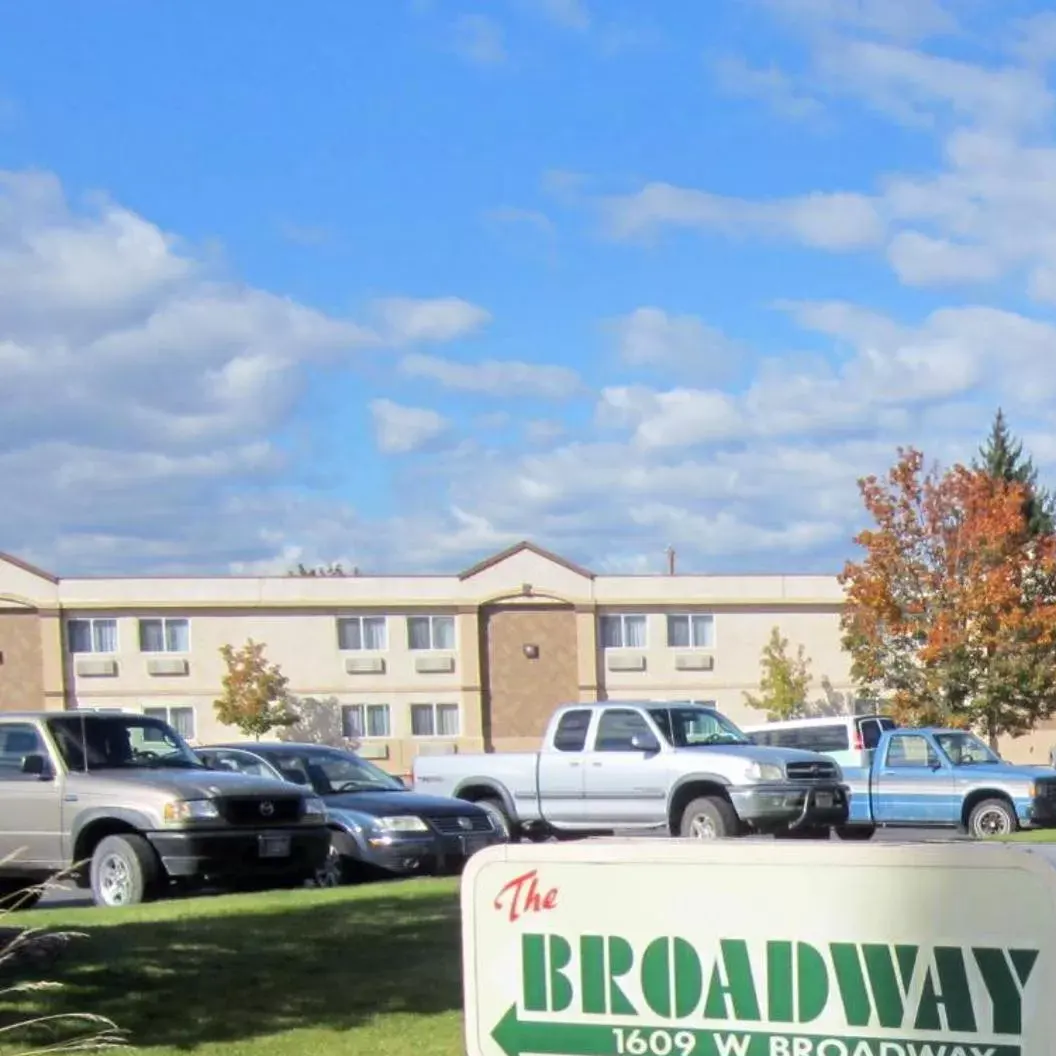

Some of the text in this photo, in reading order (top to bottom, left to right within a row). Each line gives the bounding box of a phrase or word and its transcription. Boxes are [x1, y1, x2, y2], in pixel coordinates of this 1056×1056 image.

[494, 869, 558, 922] The
[522, 933, 1040, 1034] BROADWAY
[613, 1027, 696, 1056] 1609
